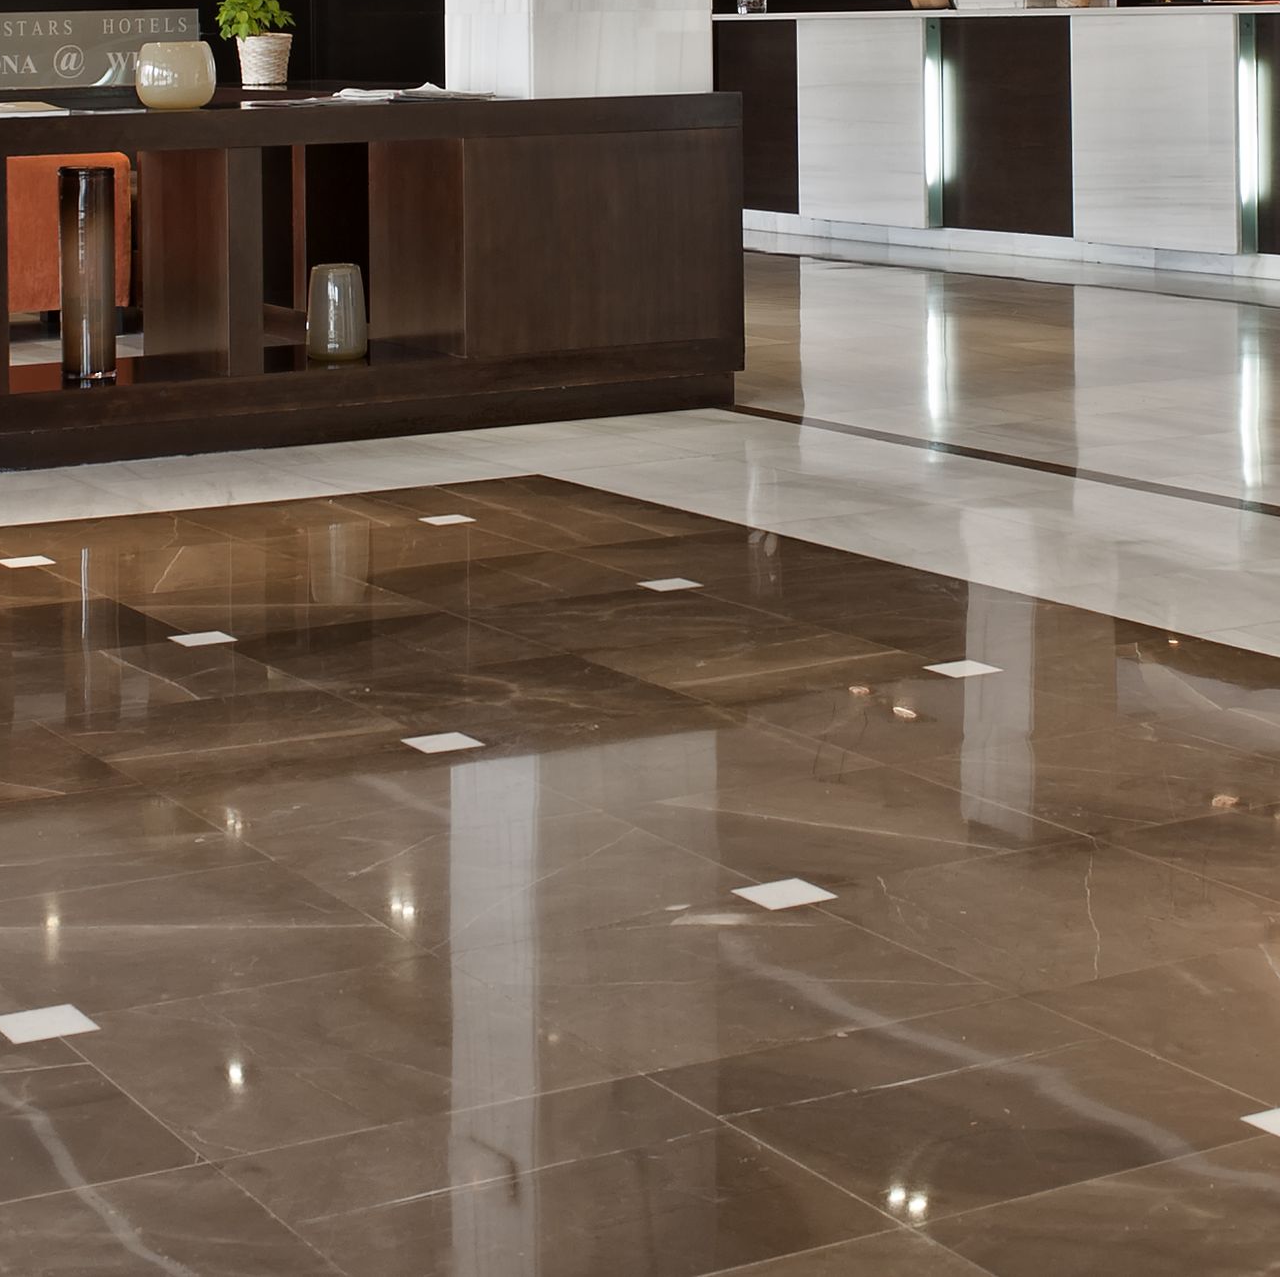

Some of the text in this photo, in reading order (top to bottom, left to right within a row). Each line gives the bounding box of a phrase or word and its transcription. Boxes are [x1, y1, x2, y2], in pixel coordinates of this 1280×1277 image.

[103, 16, 187, 35] HOTELS
[53, 44, 86, 79] @
[106, 50, 139, 72] WI
